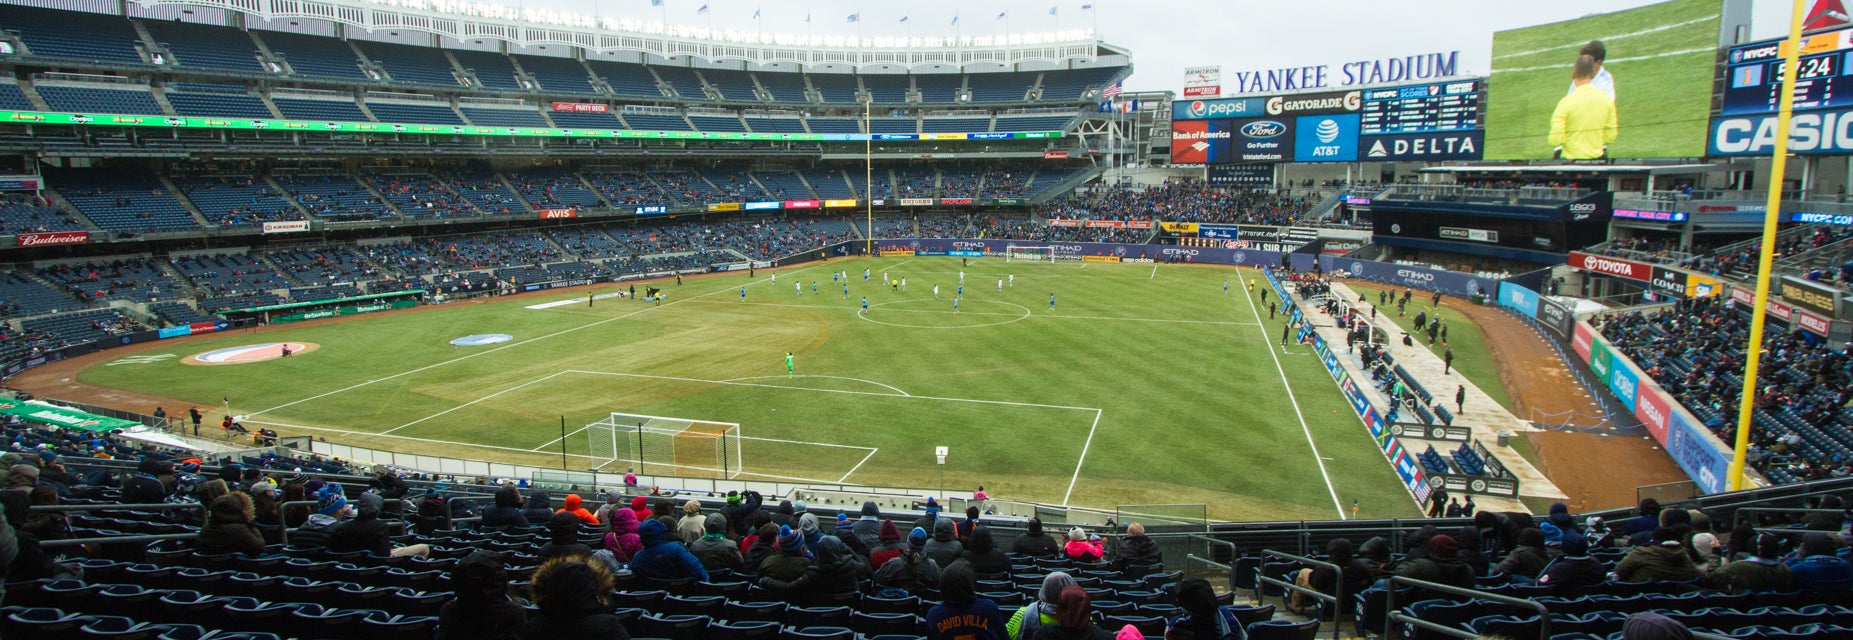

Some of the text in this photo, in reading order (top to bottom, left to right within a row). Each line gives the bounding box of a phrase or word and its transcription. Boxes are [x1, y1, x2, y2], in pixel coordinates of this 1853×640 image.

[1743, 46, 1777, 60] NYCFC
[1236, 50, 1460, 93] YANKEE STADIUM
[1776, 56, 1830, 81] 5:24
[1743, 68, 1751, 85] 1
[1373, 90, 1397, 98] NYCFC
[1209, 100, 1246, 115] pepsi
[1266, 91, 1360, 115] G GATORADE G
[1192, 131, 1199, 139] of
[1200, 130, 1230, 138] America
[1249, 123, 1277, 136] Ford
[1312, 146, 1340, 156] AT&T
[1394, 137, 1475, 155] DELTA
[547, 209, 570, 218] AVIS
[1569, 203, 1596, 211] 1893
[1614, 209, 1637, 217] SUPPORT
[1656, 212, 1671, 220] CITY
[1801, 214, 1833, 223] NYCFC
[20, 234, 86, 246] Budweiser
[1597, 259, 1632, 276] TOYOTA
[1397, 270, 1434, 281] ETIHAD
[1653, 278, 1684, 293] COACH
[937, 614, 988, 634] DAVID VILLA
